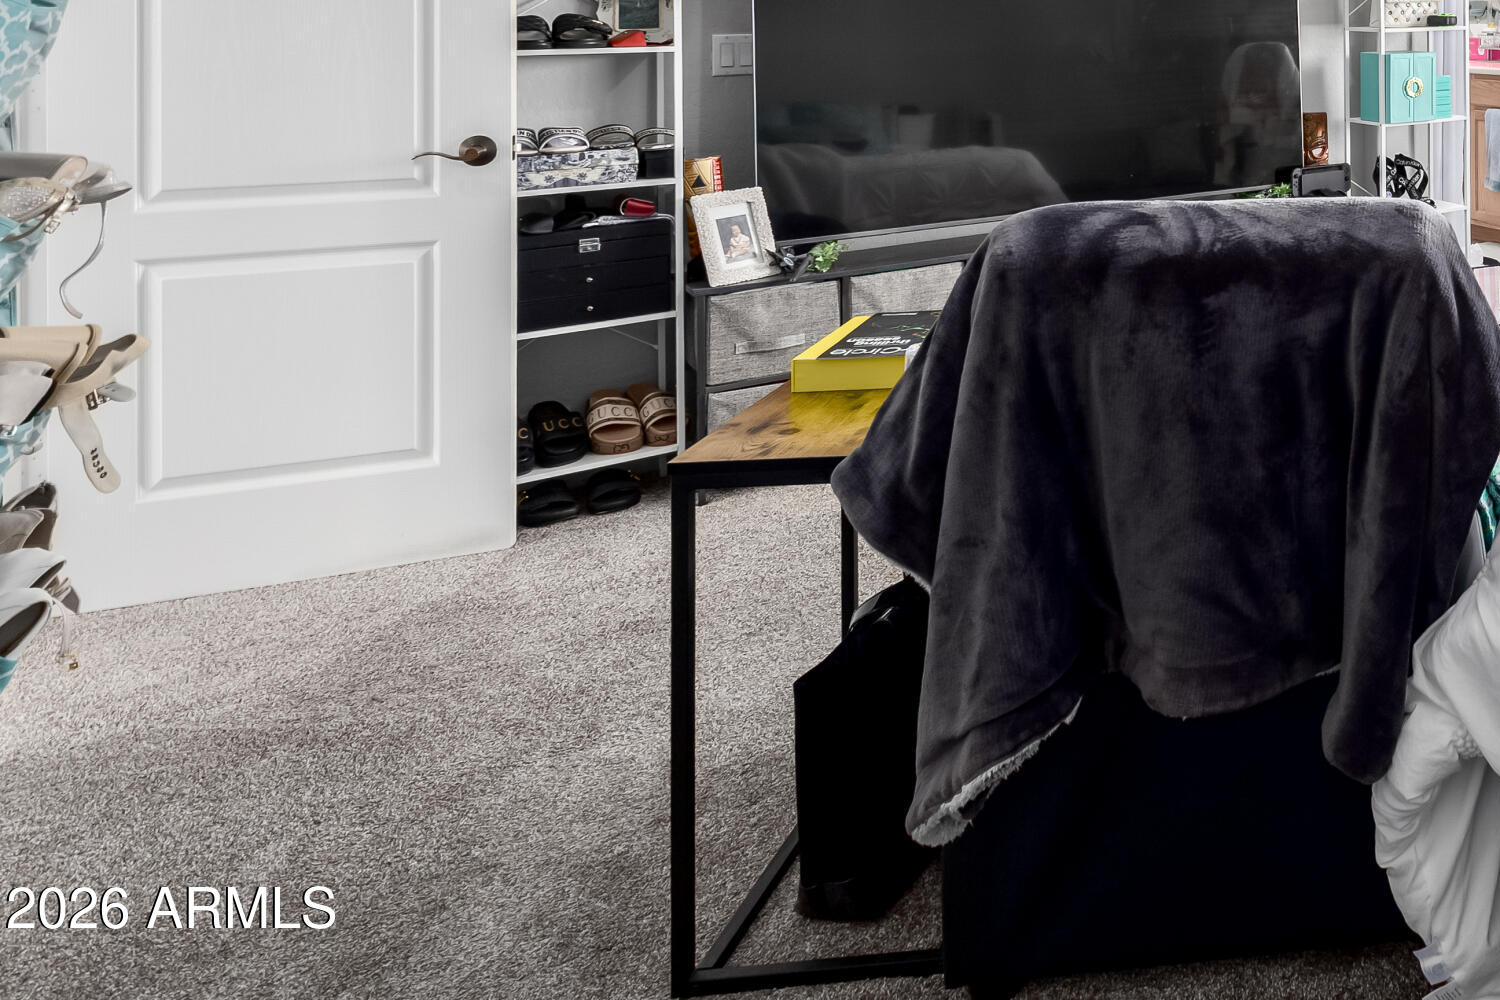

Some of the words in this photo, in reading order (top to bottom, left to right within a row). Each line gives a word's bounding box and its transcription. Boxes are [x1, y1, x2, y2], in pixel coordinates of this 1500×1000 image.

[829, 346, 907, 357] rCircle
[642, 398, 676, 417] GUC
[543, 416, 584, 432] UCC
